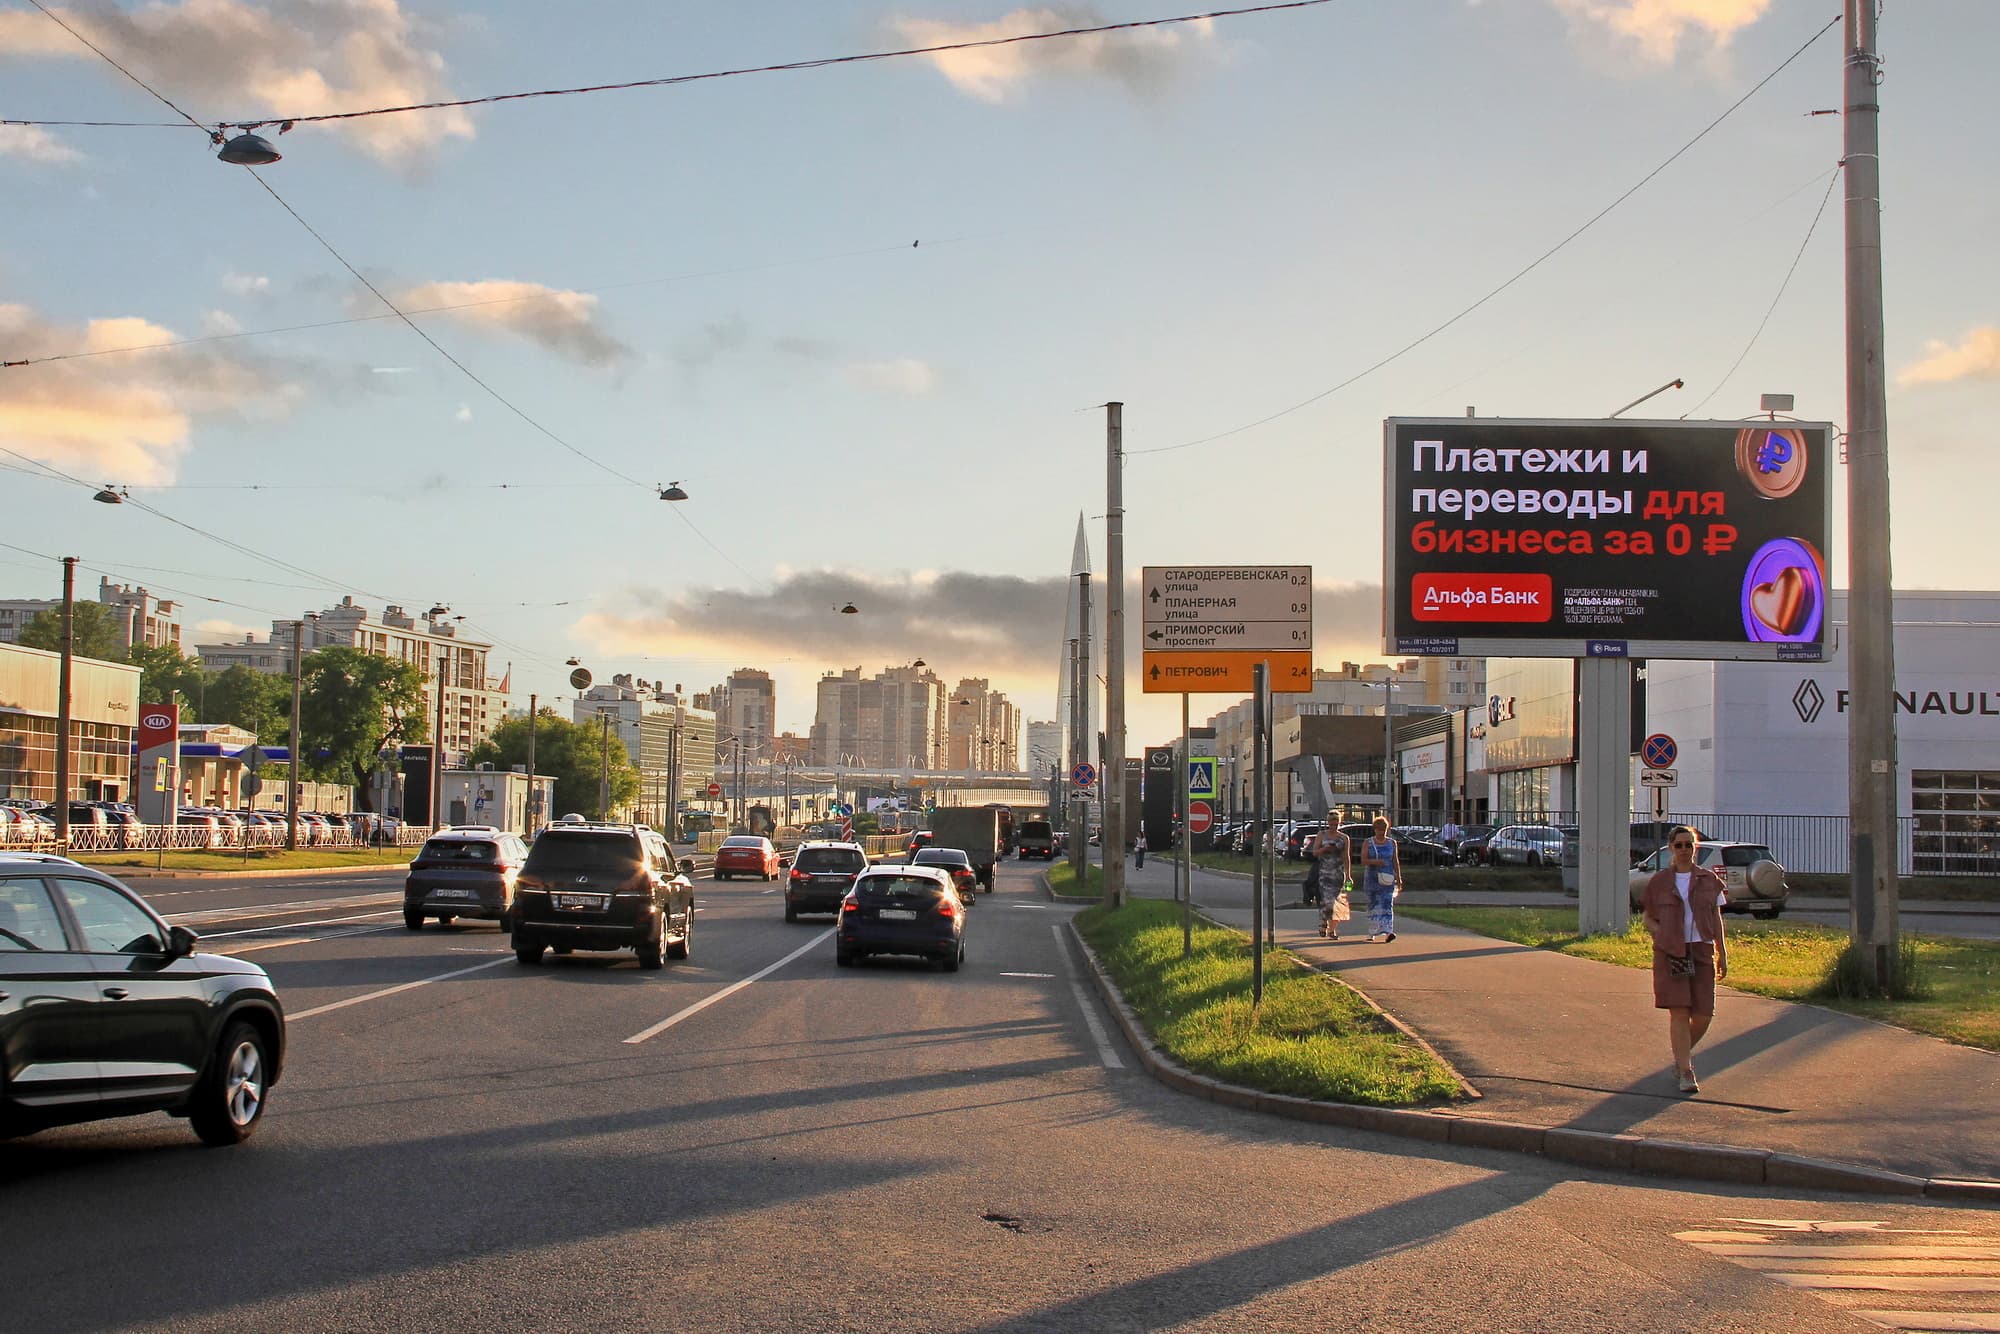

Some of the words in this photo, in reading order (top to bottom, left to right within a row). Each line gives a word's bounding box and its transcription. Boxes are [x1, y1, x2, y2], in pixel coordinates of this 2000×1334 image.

[1413, 440, 1609, 474] Платежи
[1623, 449, 1647, 473] и
[1412, 489, 1632, 520] переводы
[1643, 490, 1725, 520] для
[1411, 521, 1593, 554] бизнеса
[1604, 531, 1654, 555] за
[1666, 524, 1691, 555] 0
[1165, 570, 1288, 581] СТАРОДЕРЕВЕНСКАЯ
[1291, 576, 1307, 586] 0,2
[1165, 583, 1198, 593] улица
[1424, 587, 1487, 606] Альфа
[1491, 587, 1539, 605] Банк
[1564, 597, 1573, 606] АО
[1165, 598, 1236, 608] ПЛАНЕРНАЯ
[1291, 603, 1307, 613] 0,9
[1165, 610, 1198, 620] улица
[1165, 623, 1245, 635] ПРИМОРСКИЙ
[1292, 631, 1307, 640] 0,1
[1165, 638, 1216, 647] проспект
[1603, 645, 1621, 653] Russ
[1165, 666, 1228, 677] ПЕТРОВИЧ
[1291, 667, 1307, 677] 2,4
